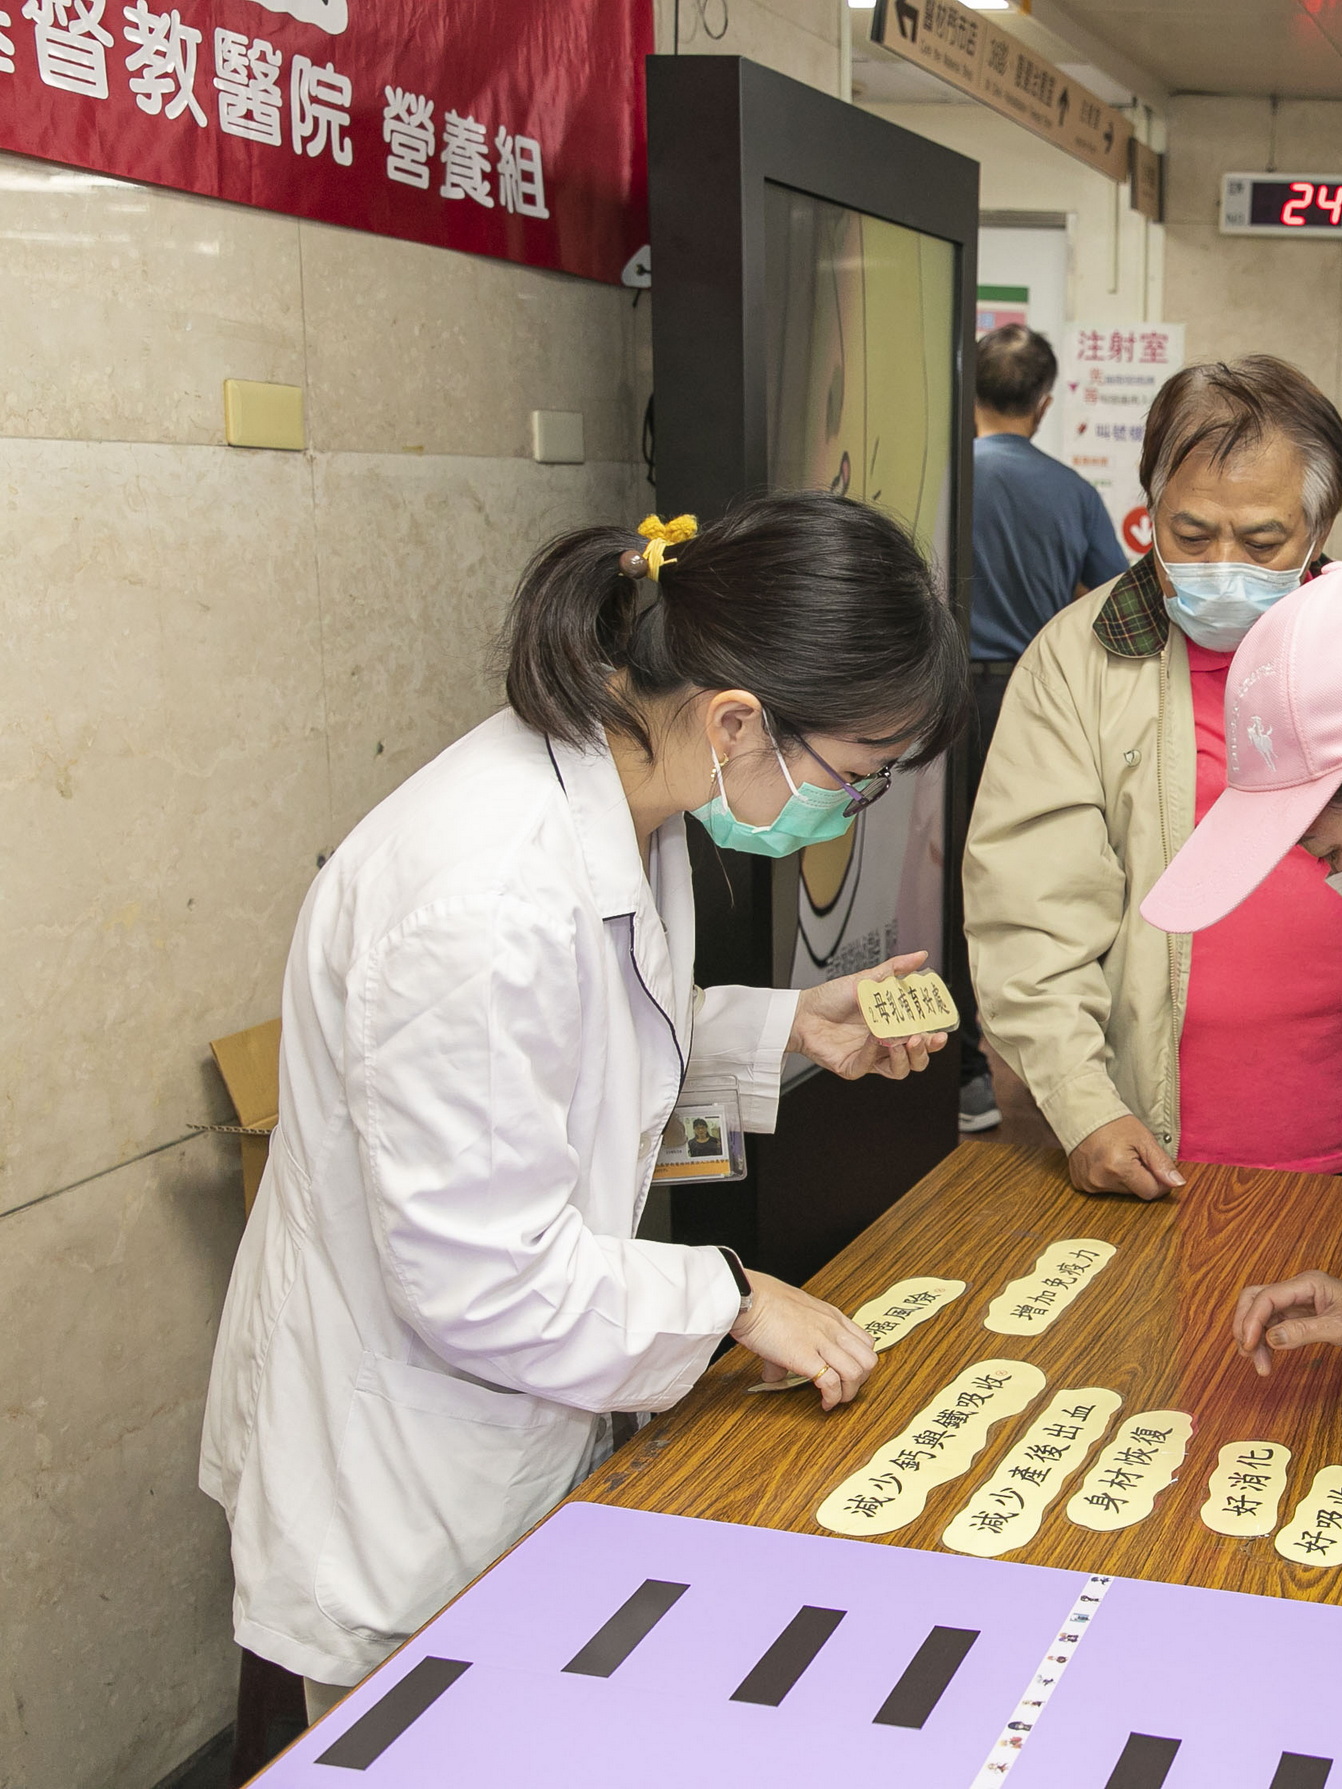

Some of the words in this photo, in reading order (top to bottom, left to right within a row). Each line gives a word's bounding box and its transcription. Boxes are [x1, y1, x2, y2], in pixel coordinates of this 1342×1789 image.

[0, 0, 353, 167] 督教醫院
[383, 84, 550, 221] 營養組
[1077, 328, 1170, 364] 注射室
[864, 1290, 942, 1342] 癌風險
[1010, 1248, 1100, 1322] 增加免疫力
[843, 1373, 1013, 1518] 減少鈣與鐵吸收
[969, 1402, 1096, 1534] 減少產後出血
[1083, 1425, 1175, 1515] 身材恢復
[1222, 1447, 1275, 1518] 好消化
